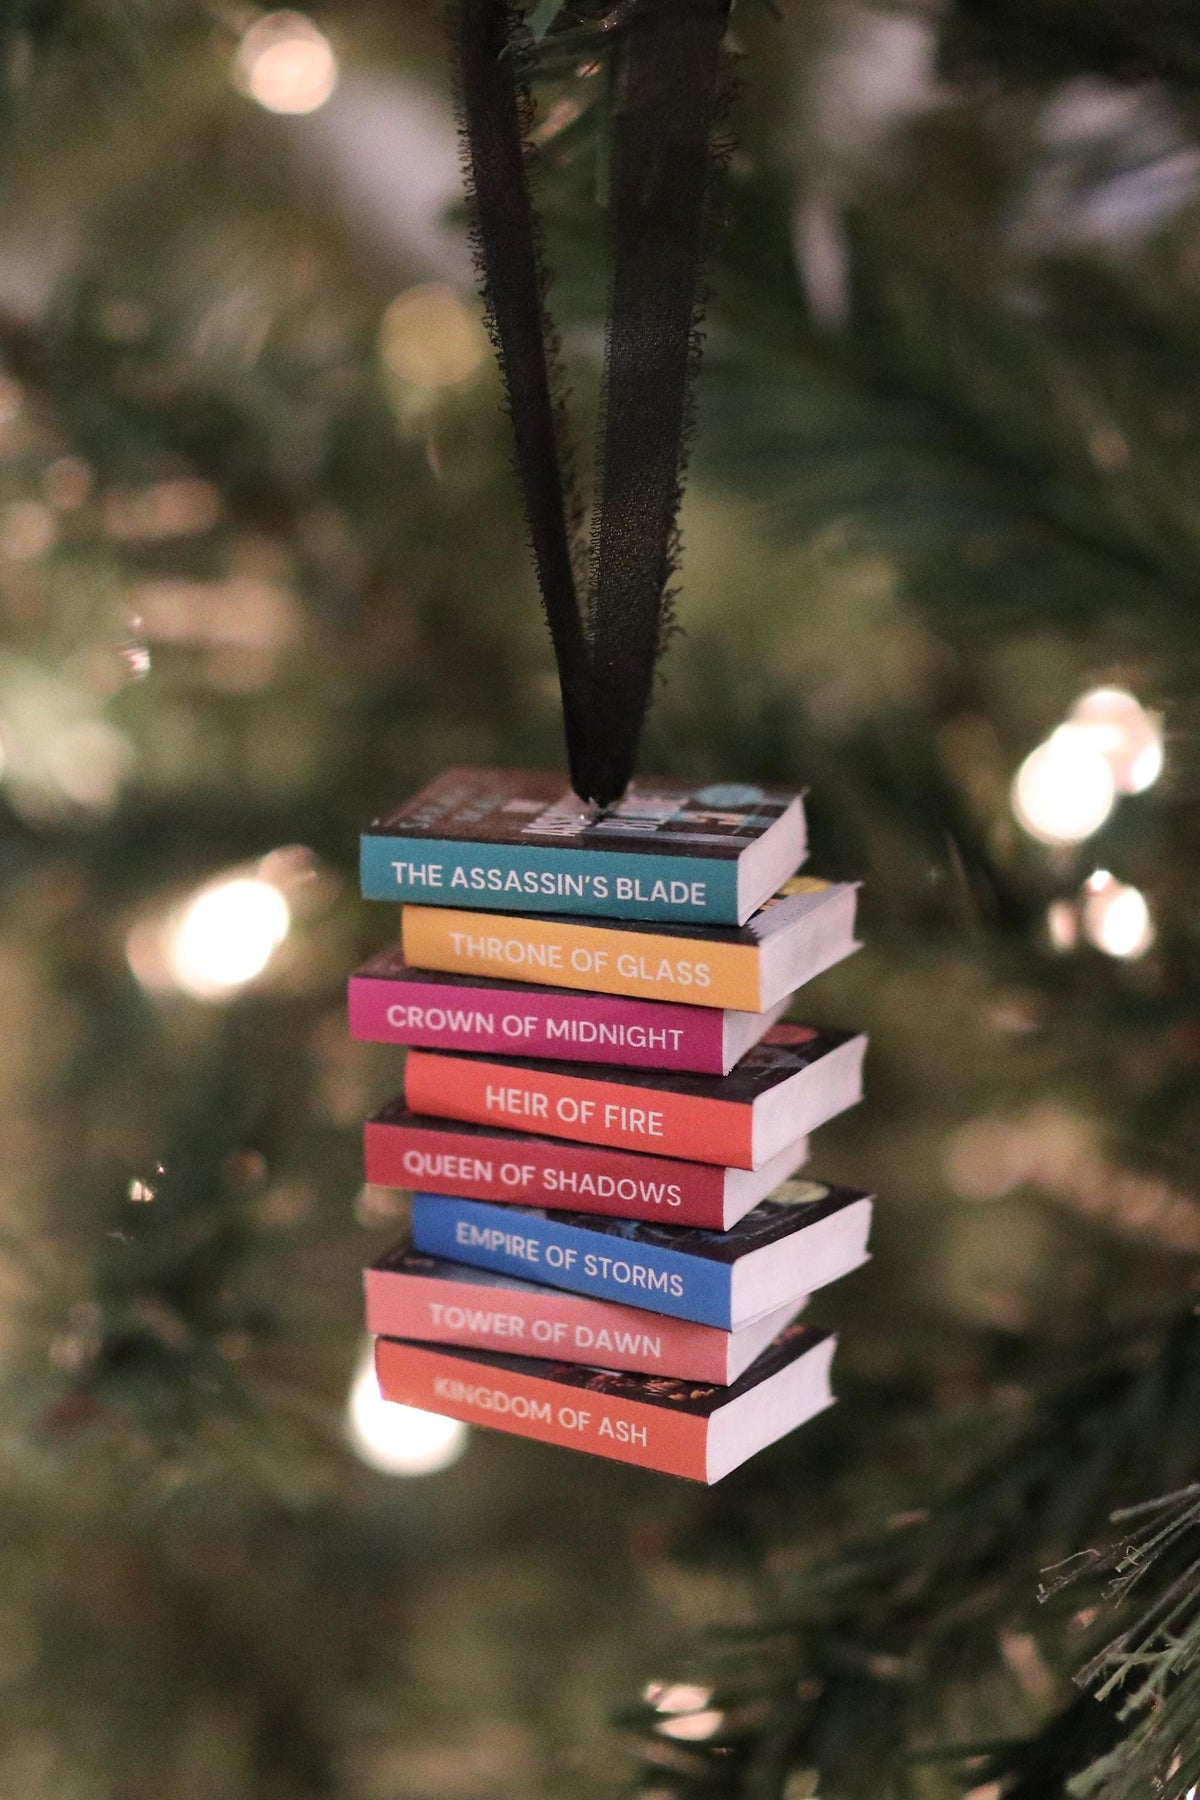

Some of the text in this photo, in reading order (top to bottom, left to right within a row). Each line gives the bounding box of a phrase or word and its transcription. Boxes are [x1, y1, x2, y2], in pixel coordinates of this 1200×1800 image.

[391, 861, 706, 906] THE ASSASSIN'S BLADE
[449, 932, 711, 987] THRONE OF GLASS
[386, 1005, 684, 1051] CROWN OF MIDNIGHT
[485, 1086, 664, 1137] HEIR OF FIRE
[403, 1150, 682, 1207] QUEEN OF SHADOWS
[456, 1222, 684, 1297] EMPIRE OF STORMS
[429, 1303, 662, 1358] TOWER OF DAWN
[434, 1376, 647, 1447] KINGDOM OF ASH
